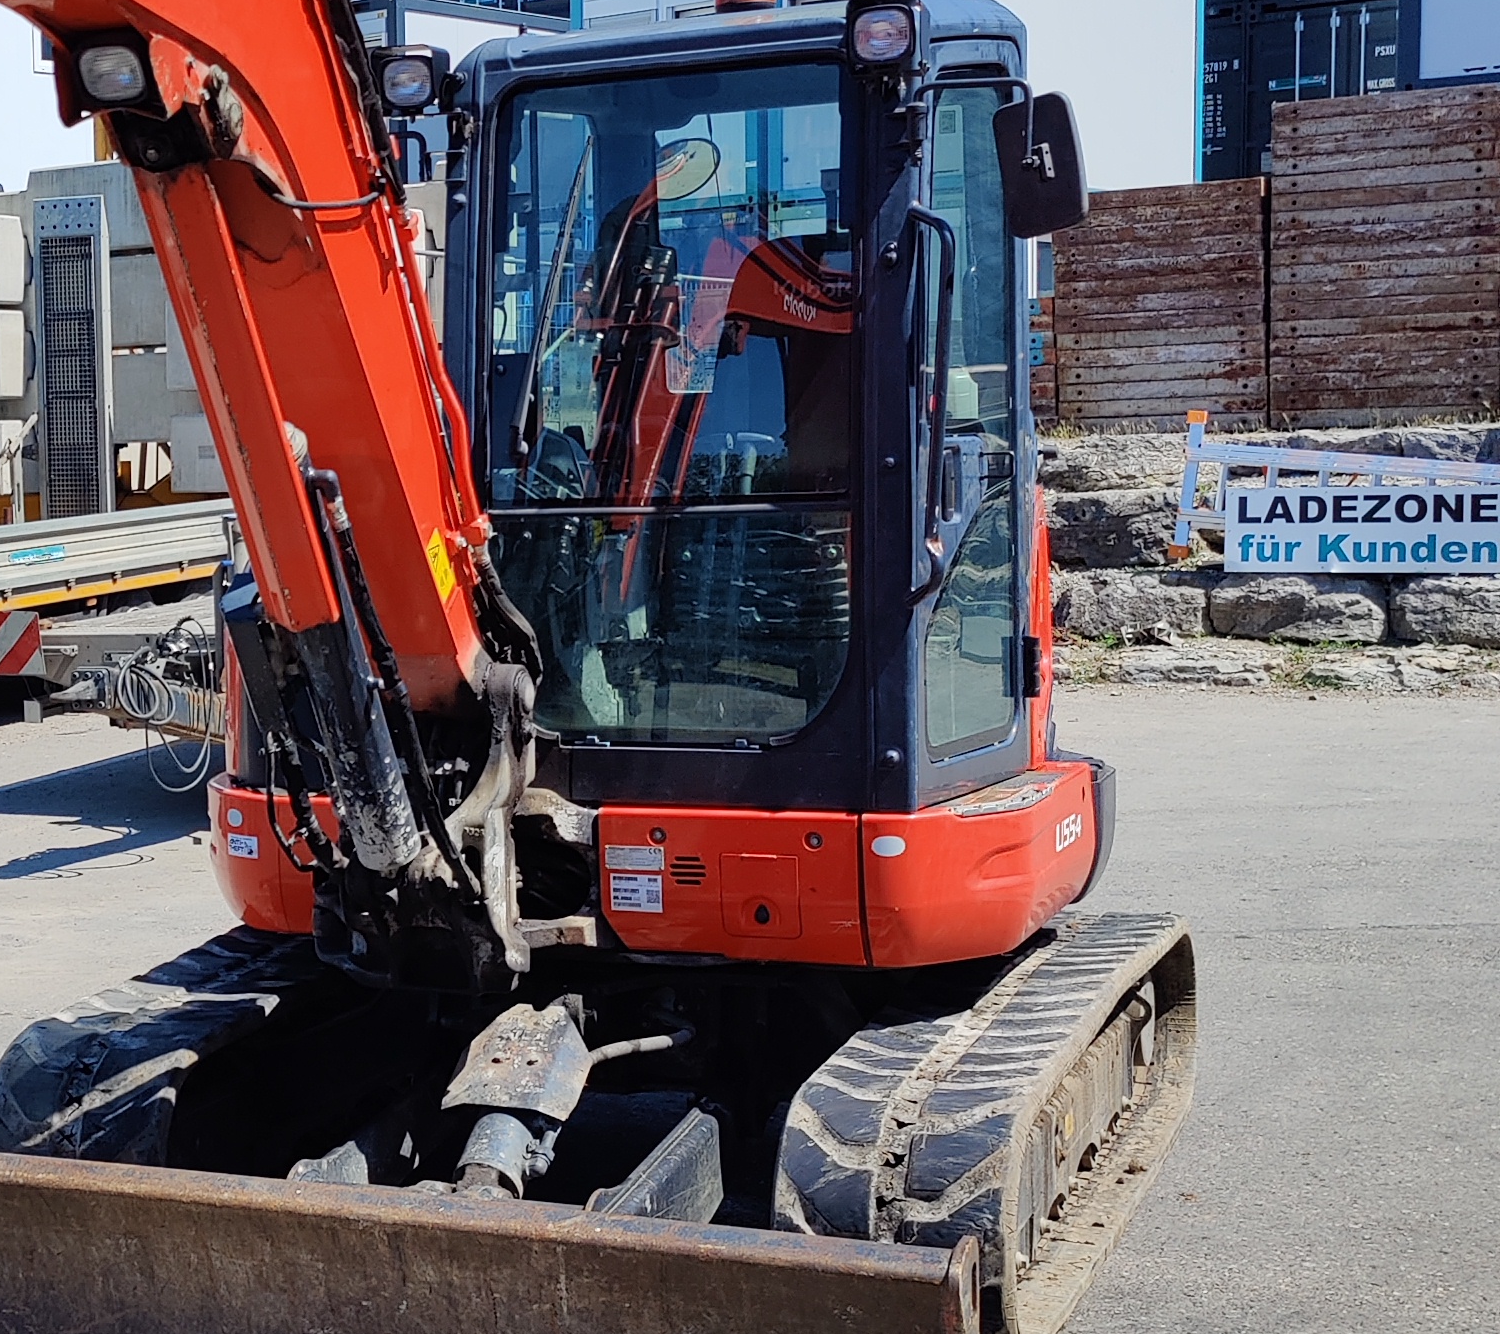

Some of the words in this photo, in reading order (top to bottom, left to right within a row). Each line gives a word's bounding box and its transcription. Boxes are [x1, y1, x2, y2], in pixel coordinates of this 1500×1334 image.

[1375, 45, 1396, 57] PSXU
[1203, 72, 1218, 84] 2G1
[1237, 494, 1499, 524] LADEZONE
[1238, 534, 1302, 563] für
[1318, 533, 1498, 563] Kunden
